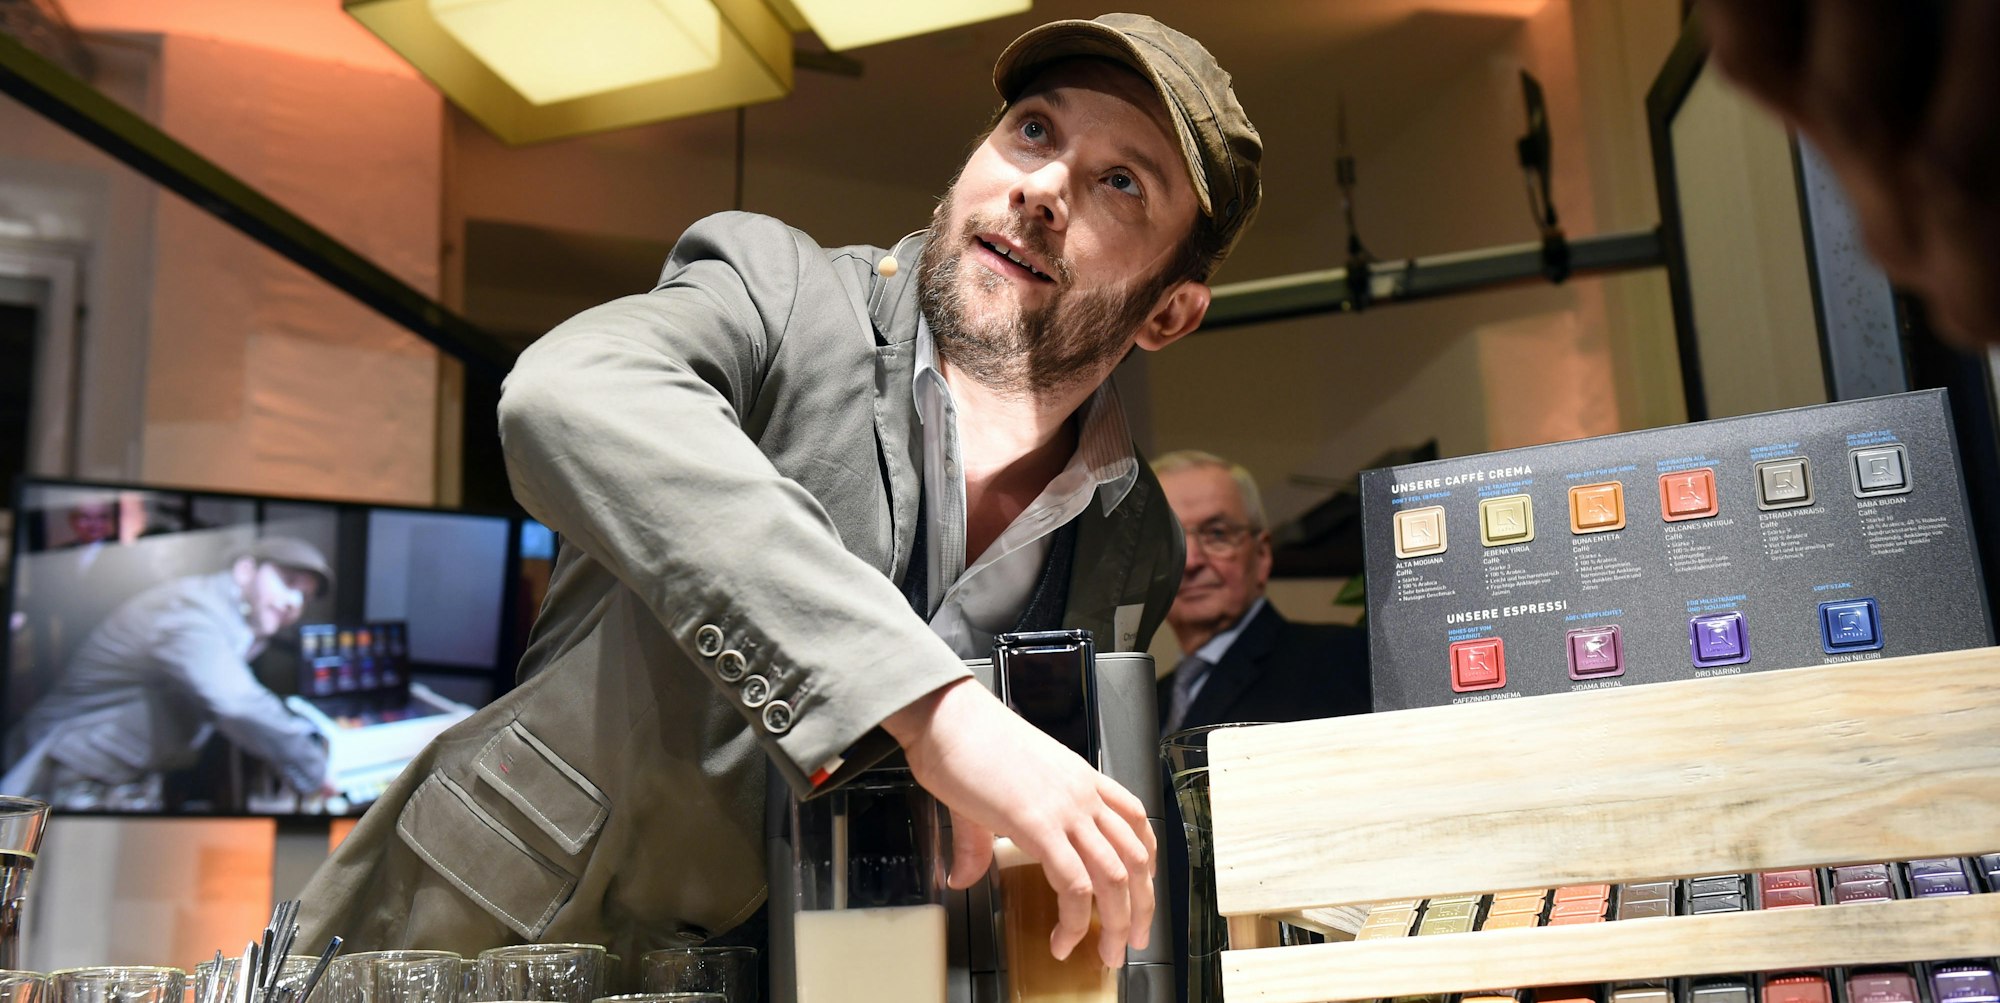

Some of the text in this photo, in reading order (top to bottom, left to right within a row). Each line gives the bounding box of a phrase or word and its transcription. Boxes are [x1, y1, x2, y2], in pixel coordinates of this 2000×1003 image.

[1391, 465, 1532, 493] UNSERE CAFFÈ CREMA
[1857, 497, 1906, 509] BABA BUDAN
[1758, 511, 1793, 520] ESTRADA
[1858, 508, 1878, 516] Caffè
[1664, 518, 1735, 533] VOLCANES ANTIGUA
[1593, 534, 1620, 543] ENTETA
[1665, 533, 1683, 541] Caffè
[1483, 549, 1509, 557] JEBENA
[1396, 561, 1413, 569] ALTA
[1483, 557, 1500, 565] Caffè
[1446, 600, 1567, 624] UNSERE ESPRESSI
[1448, 633, 1483, 641] ZUCKERHUT.
[1824, 656, 1851, 664] INDIAN
[1695, 670, 1711, 678] ORO
[1571, 683, 1599, 691] SIDAMA
[1491, 691, 1522, 700] IPANEMA
